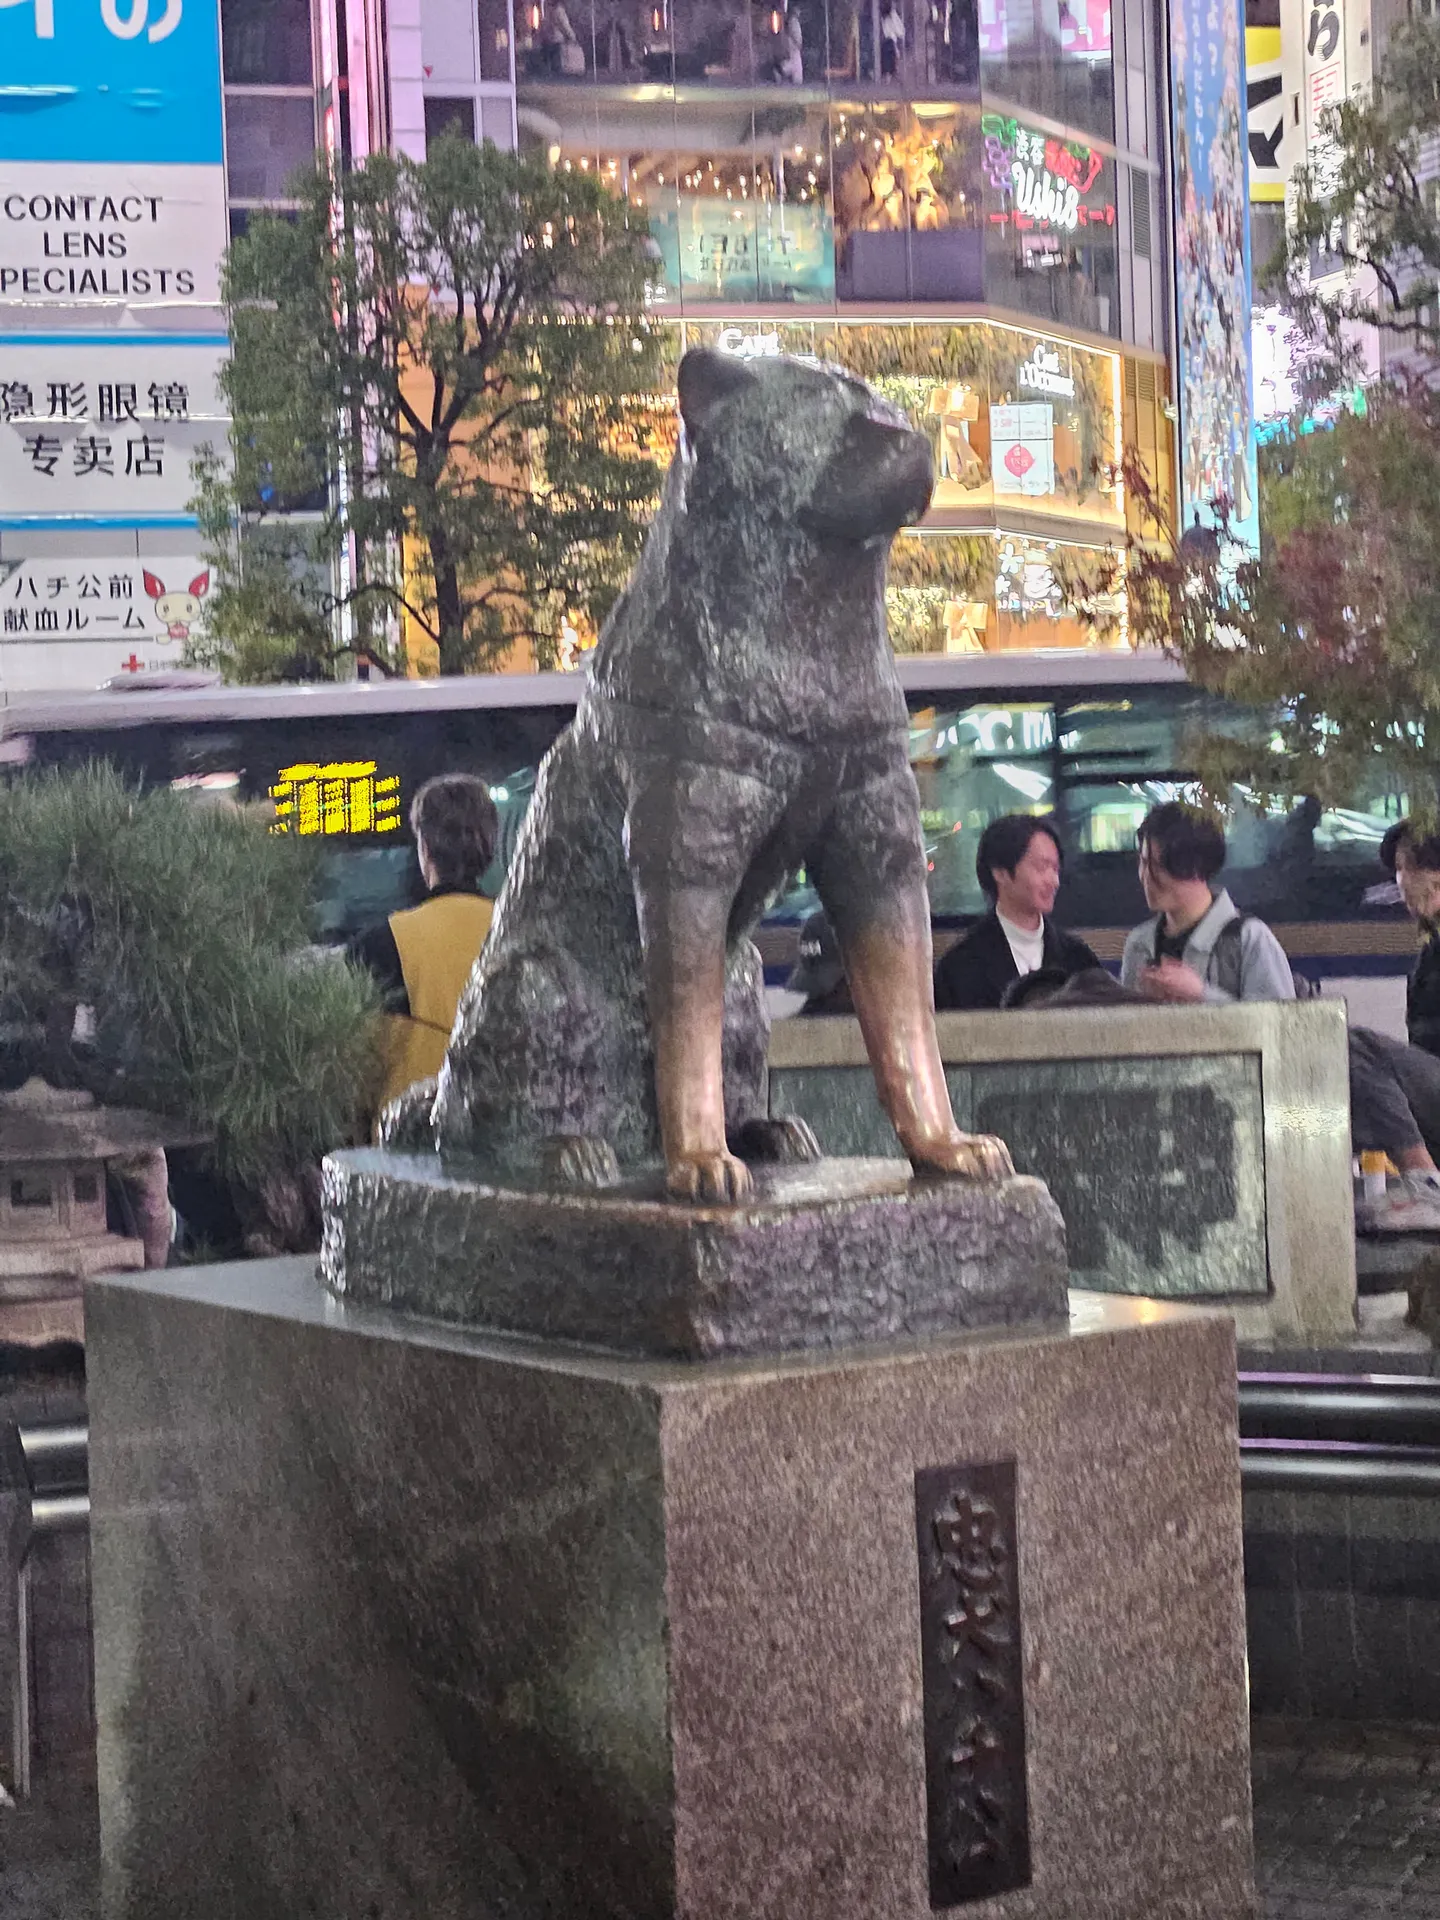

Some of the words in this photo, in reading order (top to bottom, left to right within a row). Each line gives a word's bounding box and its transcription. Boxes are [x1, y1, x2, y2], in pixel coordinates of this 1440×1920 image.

[4, 194, 163, 222] CONTACT
[43, 231, 128, 258] LENS
[0, 381, 191, 424] 隐形眼镜
[23, 434, 165, 477] 专卖店
[15, 573, 134, 600] ハチ公前
[3, 606, 146, 633] 献血ルーム
